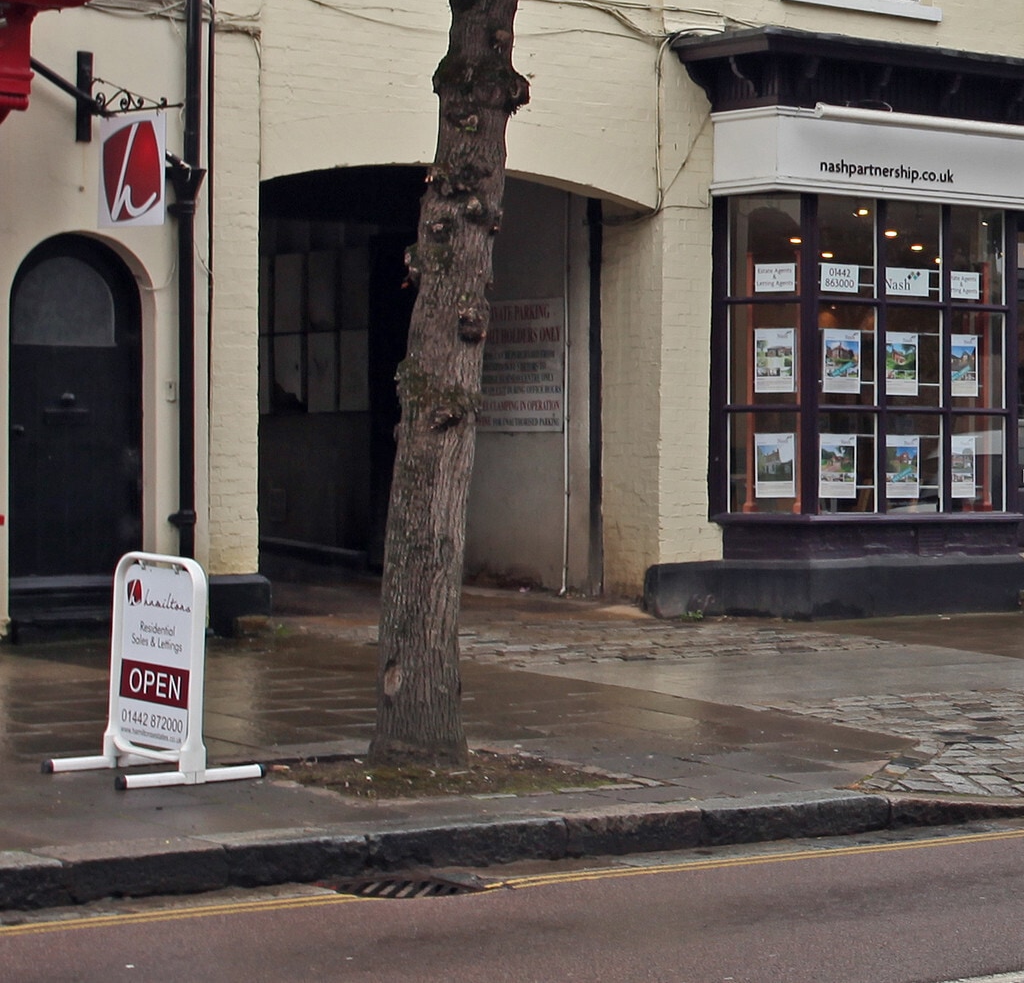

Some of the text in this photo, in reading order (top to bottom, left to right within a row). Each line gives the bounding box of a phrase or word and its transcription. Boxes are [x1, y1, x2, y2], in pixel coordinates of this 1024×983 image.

[820, 159, 954, 183] nashpartnership.co.uk
[829, 267, 851, 278] 01442
[825, 278, 855, 288] 863000
[514, 304, 550, 321] PARKING
[539, 326, 561, 342] ONLY
[143, 588, 191, 613] hamiltons
[140, 620, 176, 636] Residential
[131, 633, 183, 654] Sales & Lettings
[129, 668, 181, 701] OPEN
[121, 708, 183, 734] 01442 872000
